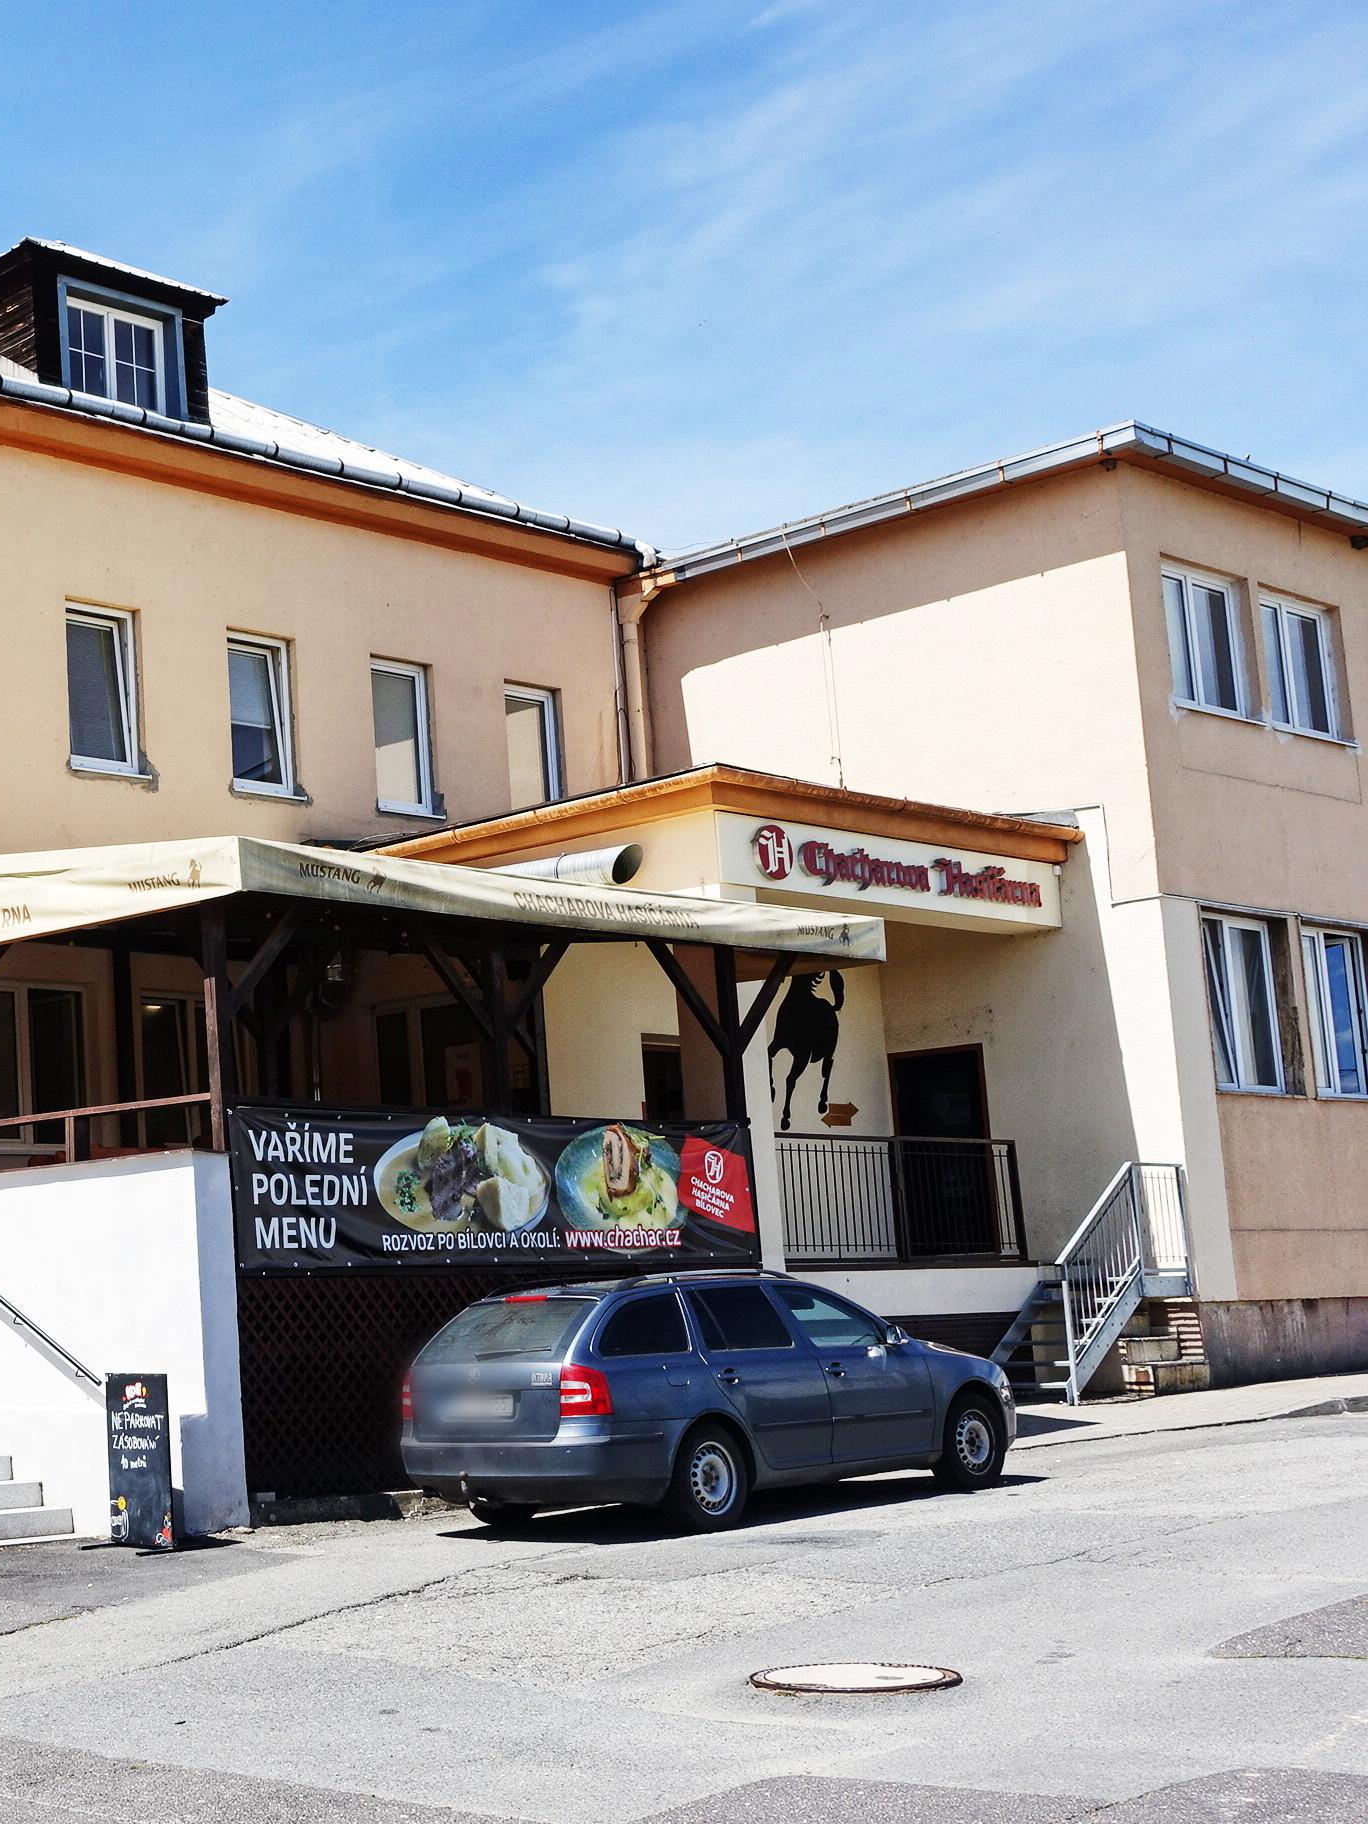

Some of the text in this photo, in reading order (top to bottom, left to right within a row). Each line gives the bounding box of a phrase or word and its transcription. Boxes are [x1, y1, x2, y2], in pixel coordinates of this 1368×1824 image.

[127, 871, 181, 892] MUSTANG
[299, 862, 361, 884] MUSTANG
[513, 892, 700, 930] CHACHAROVA HASIČÁRNA
[797, 924, 835, 940] MUSTANG
[248, 1121, 354, 1164] VAŘÍME
[252, 1165, 368, 1206] POLEDNÍ
[691, 1176, 735, 1204] CHACHAROVA
[692, 1187, 730, 1211] HASIČÁRNA
[695, 1198, 725, 1219] BÍLOVEC
[254, 1217, 337, 1249] MENU
[382, 1232, 435, 1252] ROZVOZ
[437, 1233, 455, 1250] PO
[458, 1228, 507, 1249] BÍLOVCI
[509, 1231, 519, 1249] A
[521, 1227, 561, 1248] OKOLÍ:
